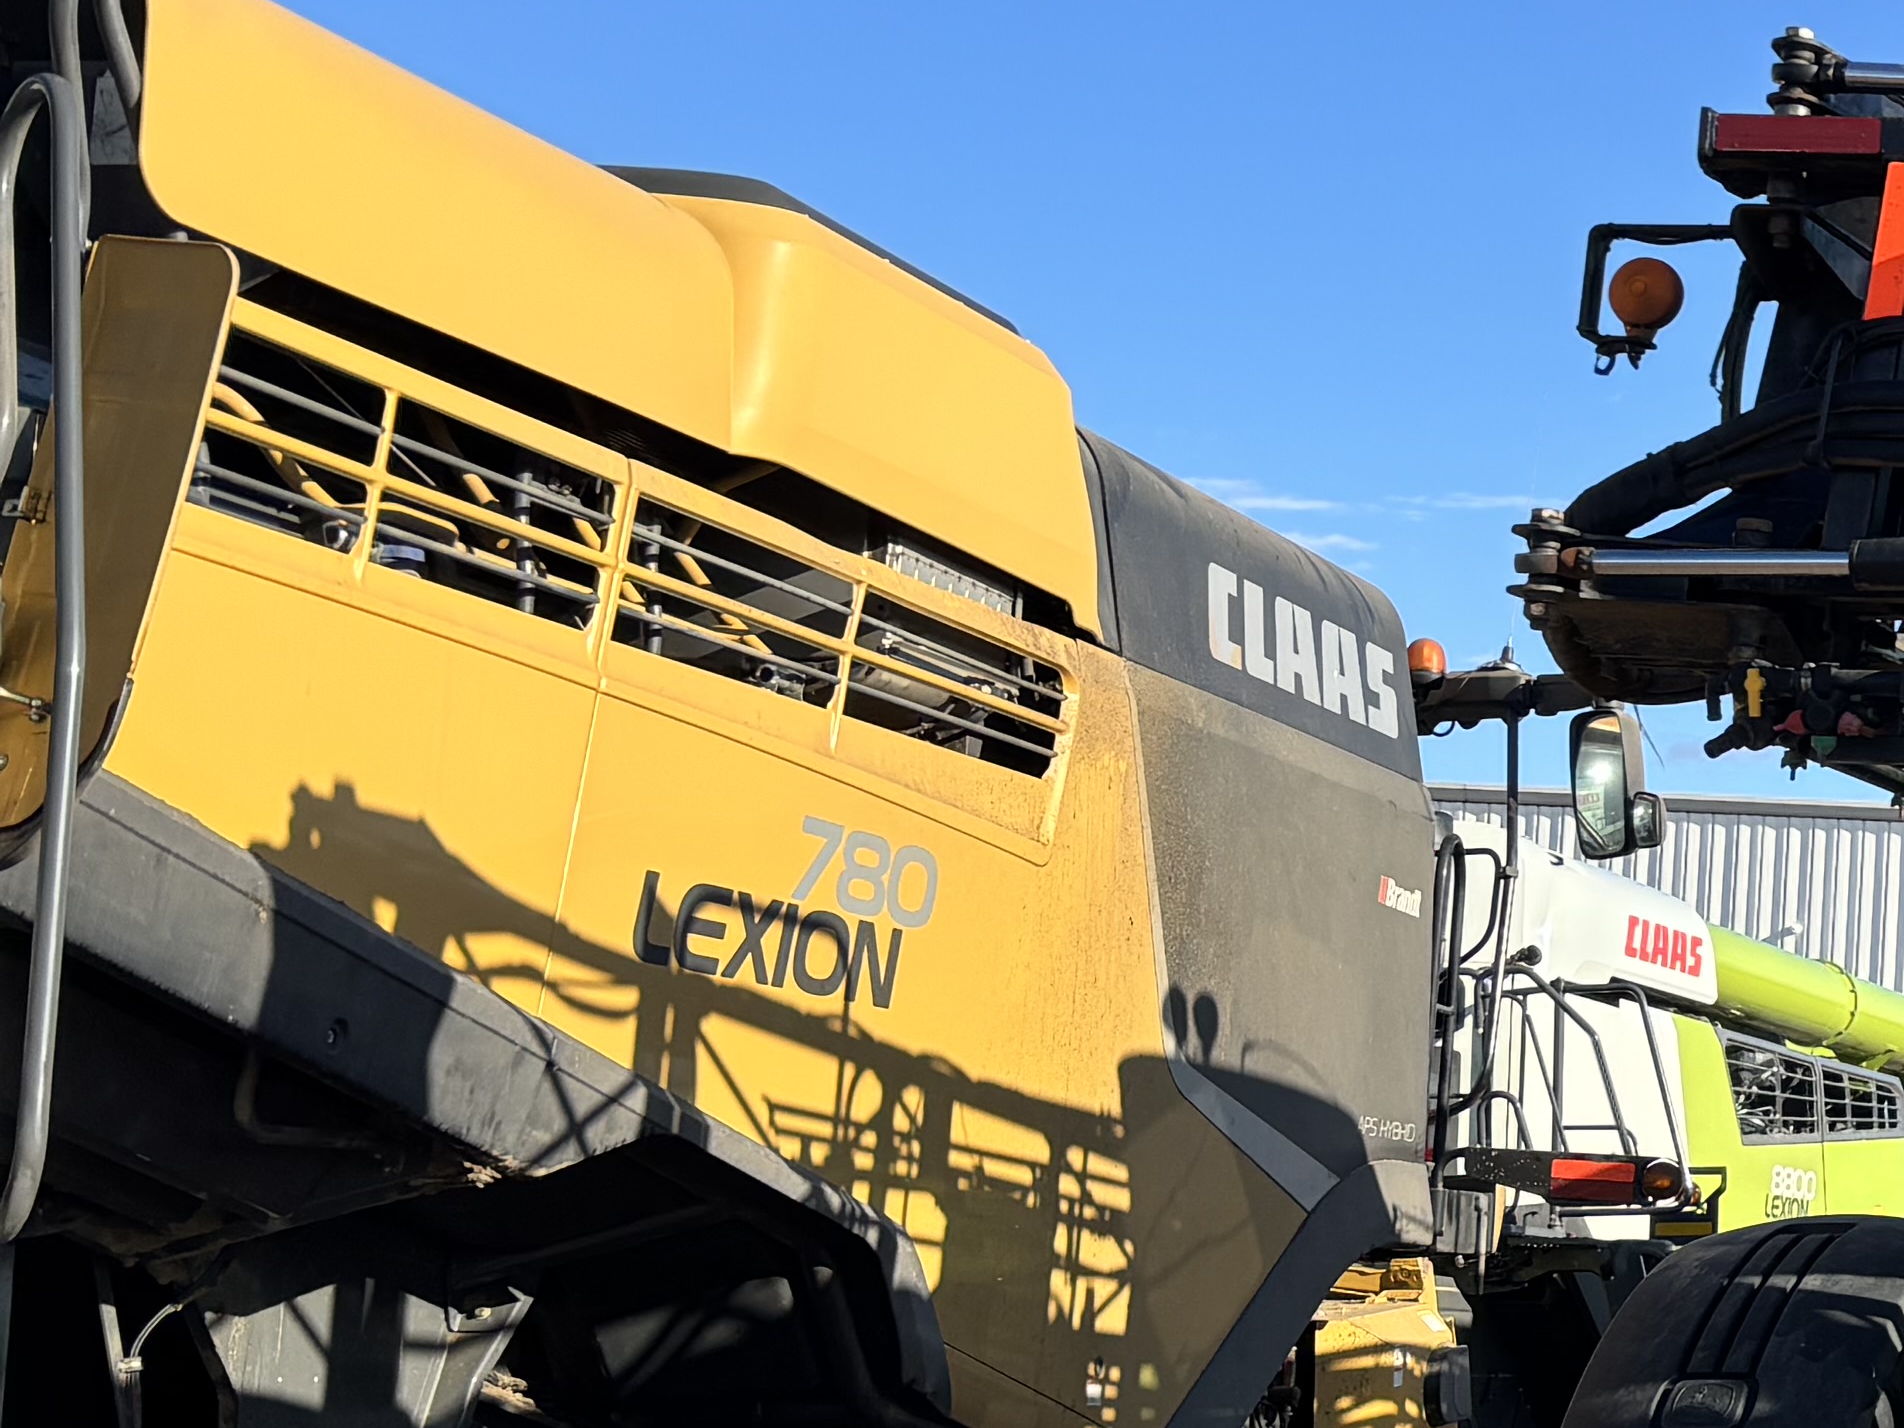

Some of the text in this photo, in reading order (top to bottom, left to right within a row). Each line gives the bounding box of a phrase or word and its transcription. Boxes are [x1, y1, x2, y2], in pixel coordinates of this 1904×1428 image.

[1208, 562, 1399, 739] CLAAS
[791, 815, 939, 928] 780
[633, 870, 903, 1009] LEXION
[1625, 915, 1703, 977] CLAAS
[1357, 1115, 1379, 1137] APS
[1765, 1193, 1810, 1218] LEXION
[1770, 1164, 1817, 1200] 8800
